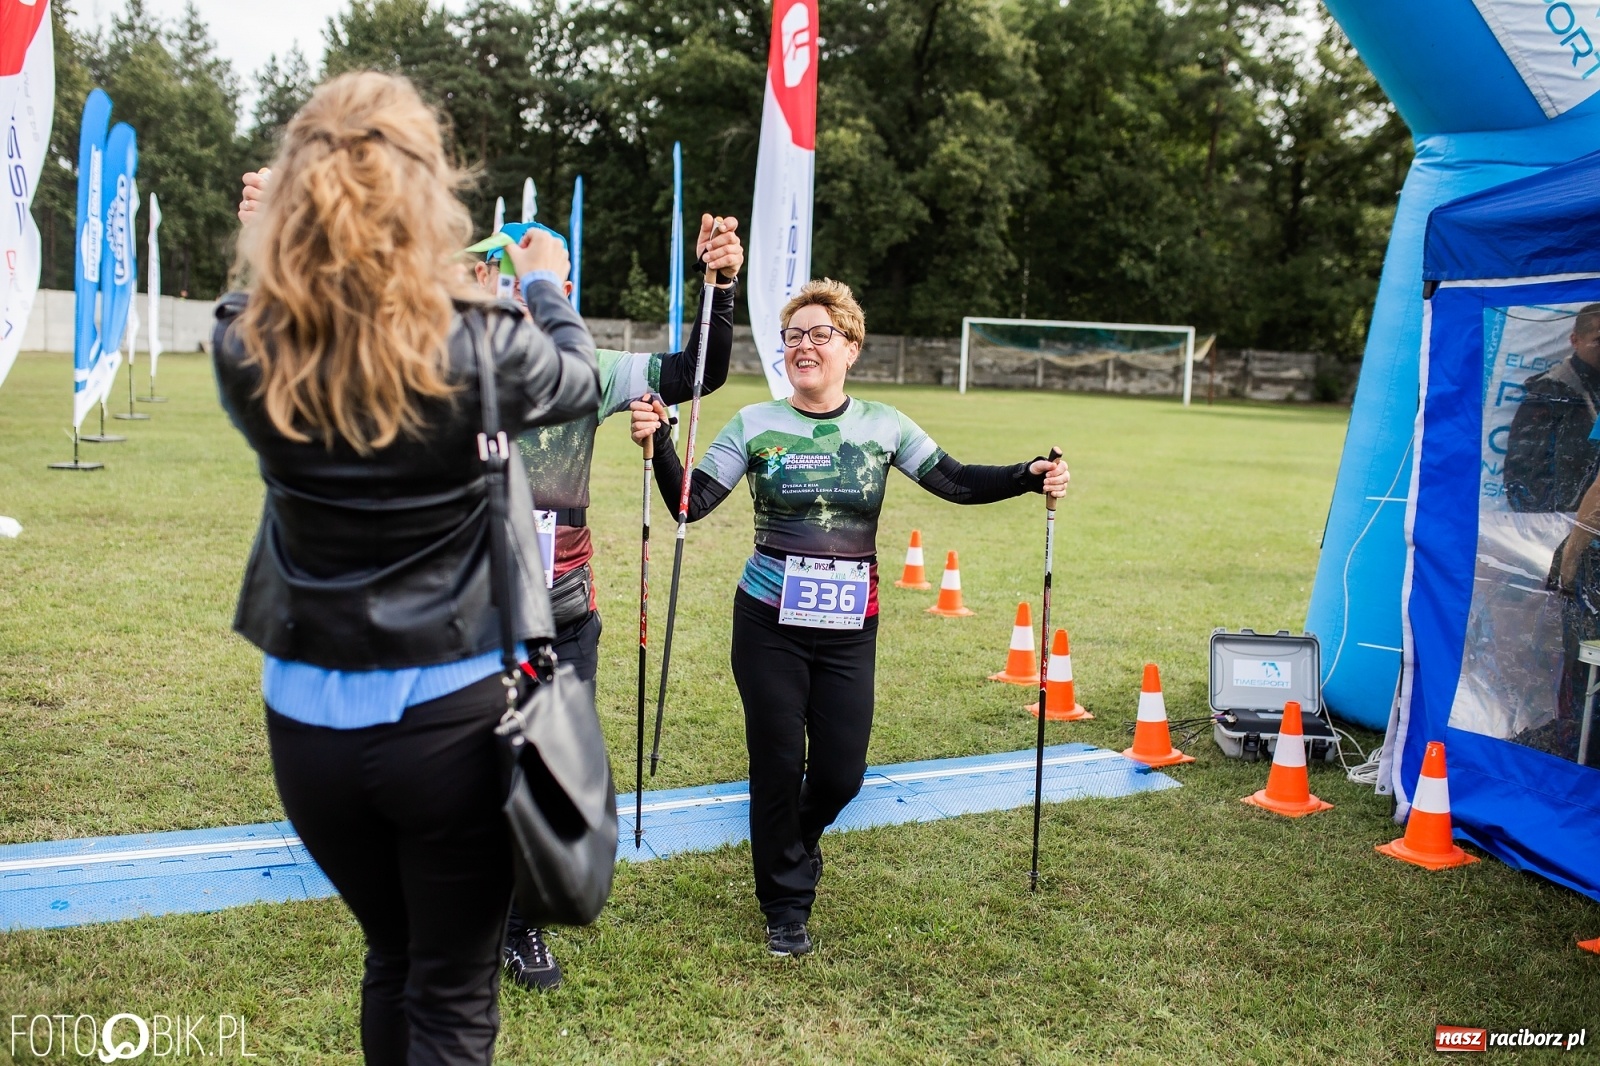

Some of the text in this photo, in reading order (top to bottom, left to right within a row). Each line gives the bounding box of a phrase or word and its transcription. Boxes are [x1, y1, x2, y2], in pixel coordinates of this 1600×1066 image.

[1544, 0, 1600, 80] ORT
[797, 581, 856, 612] 336
[1234, 679, 1290, 688] TIMESPORT
